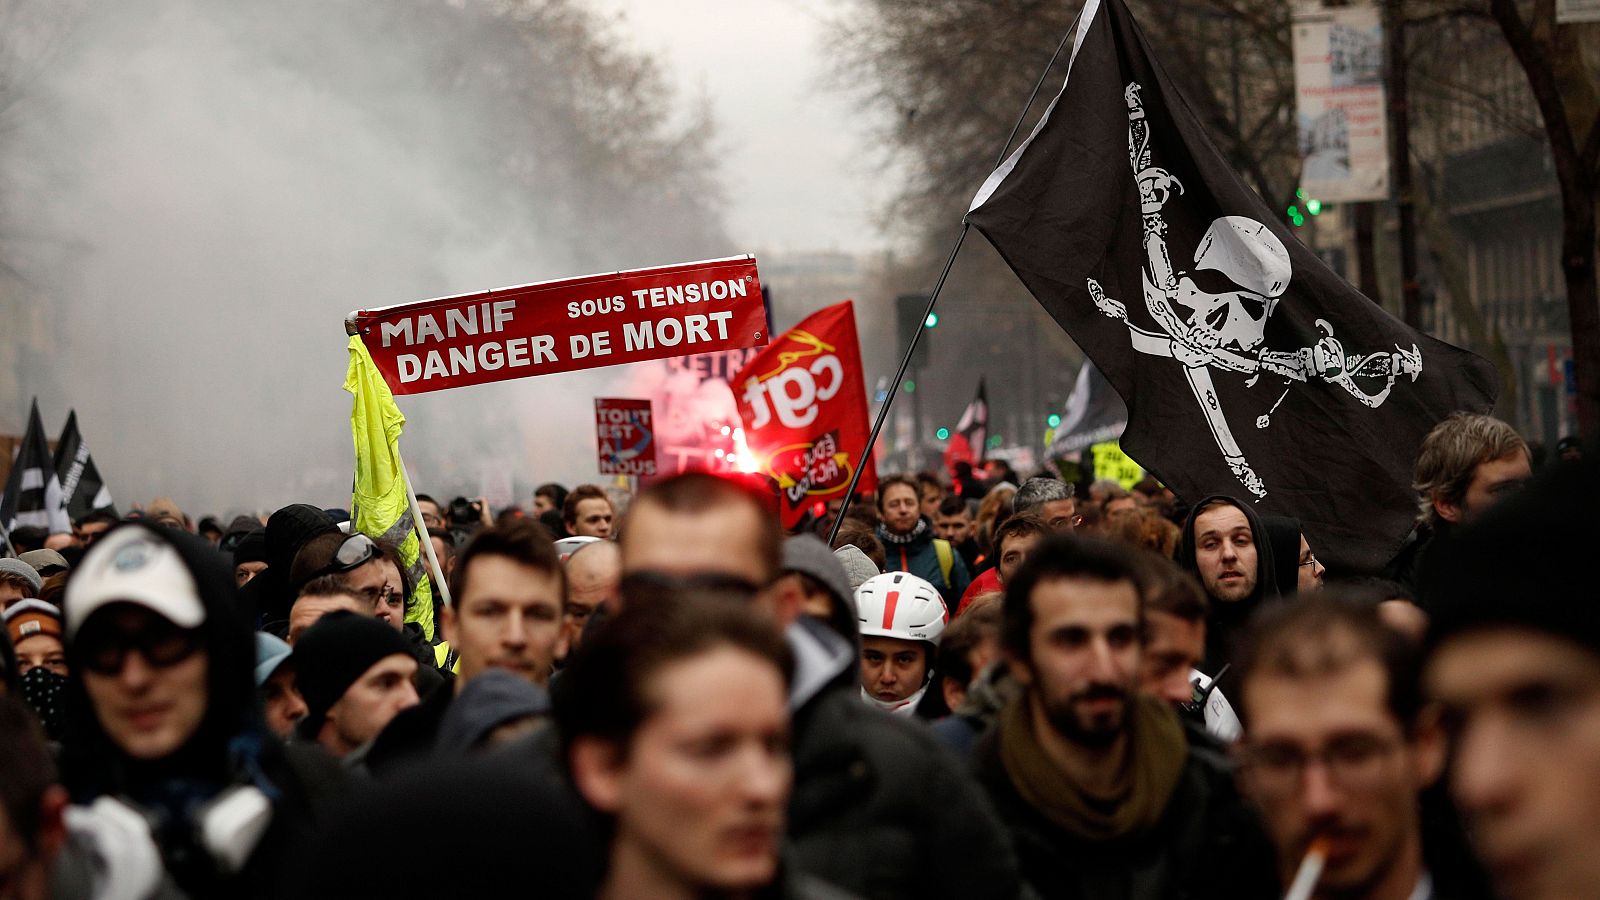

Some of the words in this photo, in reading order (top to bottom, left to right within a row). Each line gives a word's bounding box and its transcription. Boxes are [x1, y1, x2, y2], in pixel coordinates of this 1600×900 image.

[380, 299, 516, 348] MANIF
[567, 295, 626, 319] SOUS
[631, 278, 747, 310] TENSION
[396, 334, 559, 384] DANGER
[569, 331, 612, 360] DE
[622, 311, 733, 352] MORT
[600, 459, 657, 476] NOUS
